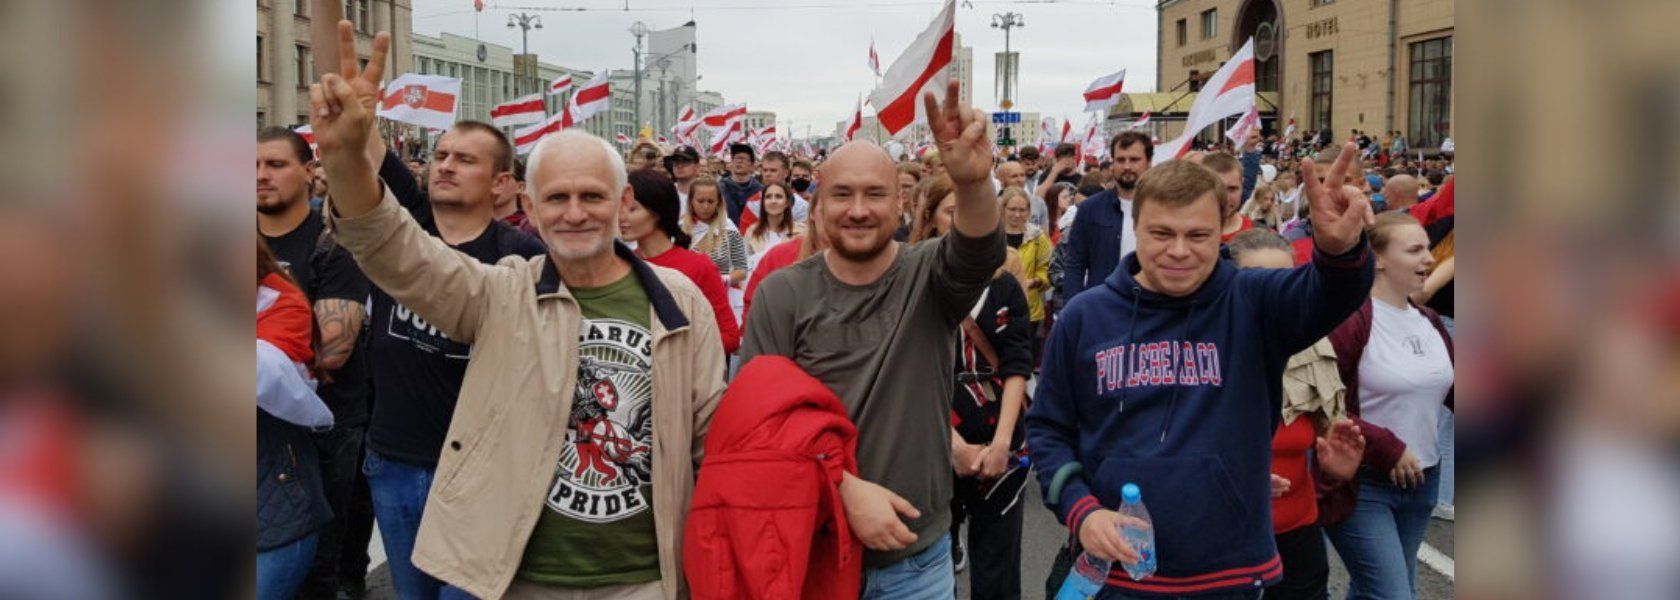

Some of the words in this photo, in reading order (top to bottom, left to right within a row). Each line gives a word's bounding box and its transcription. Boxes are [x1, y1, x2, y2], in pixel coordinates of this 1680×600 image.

[1306, 16, 1340, 39] HOTEL
[579, 323, 652, 357] ARUS
[552, 486, 641, 516] PRIDE
